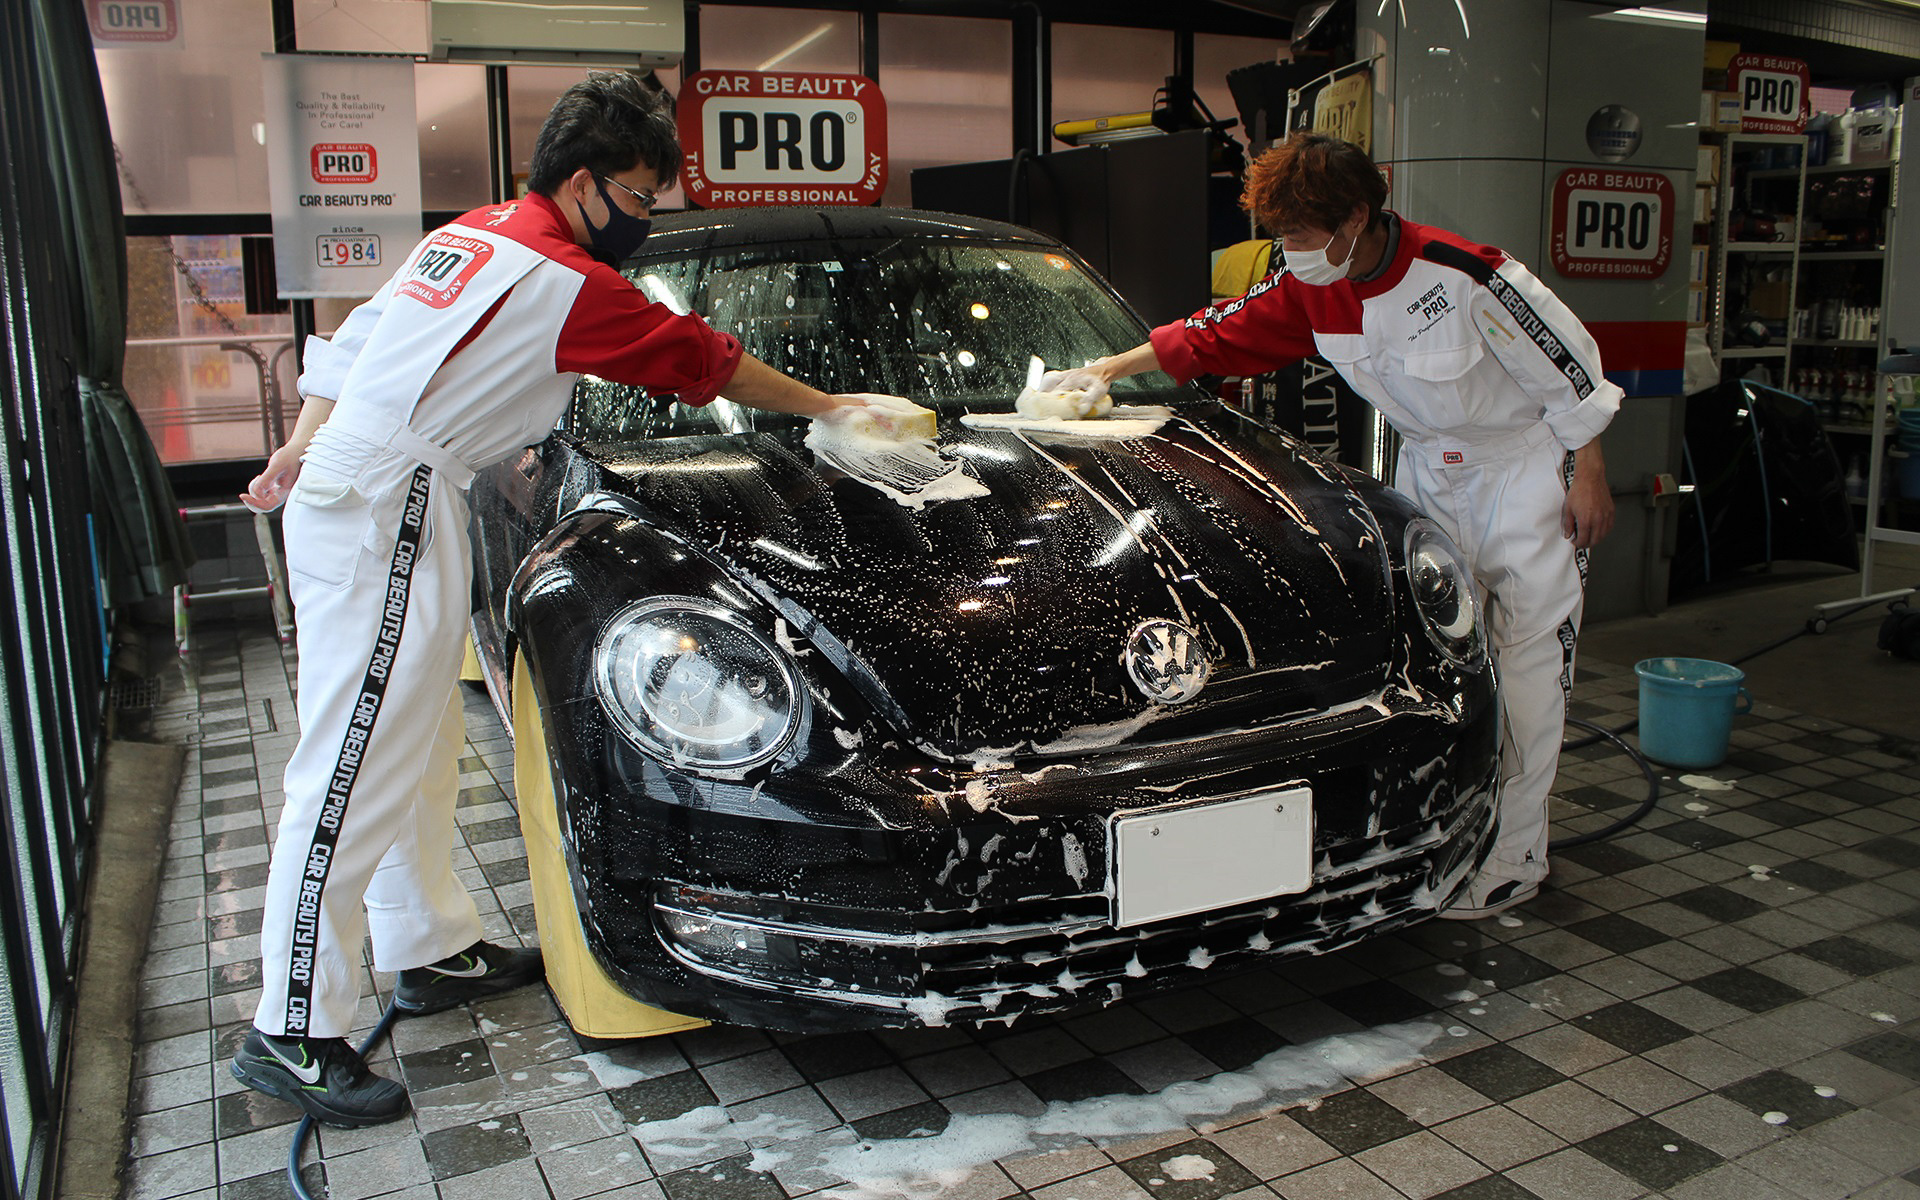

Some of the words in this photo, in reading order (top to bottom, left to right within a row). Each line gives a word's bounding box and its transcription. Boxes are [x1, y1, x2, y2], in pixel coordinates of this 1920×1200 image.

[1736, 56, 1759, 67] CAR
[1763, 58, 1803, 73] BEAUTY
[321, 92, 337, 100] The
[341, 92, 360, 100] Best
[696, 76, 749, 94] CAR
[763, 77, 866, 97] BEAUTY
[1744, 76, 1794, 115] PRO
[296, 102, 329, 111] Quality
[332, 102, 339, 110] &
[341, 102, 386, 111] Reliability
[308, 111, 317, 119] In
[320, 111, 375, 119] Professional
[320, 121, 336, 129] Car
[339, 121, 363, 129] Care!
[1743, 121, 1796, 133] ROFESSIONAL
[719, 110, 846, 172] PRO
[323, 154, 364, 173] PRO
[686, 151, 705, 192] THE
[863, 152, 881, 191] WAY
[711, 190, 858, 202] PROFESSIONAL
[1566, 173, 1598, 187] CAR
[1604, 174, 1664, 191] BEAUTY
[299, 194, 322, 207] CAR
[324, 194, 368, 207] BEAUTY
[1575, 200, 1650, 250] PRO
[321, 243, 376, 265] 1984
[451, 237, 490, 253] BEAUTY
[1556, 232, 1566, 264] THE
[1657, 236, 1669, 265] WAY
[1567, 263, 1653, 274] PROFESSIONAL
[440, 279, 463, 301] WAY
[1406, 301, 1422, 315] CAR
[1419, 281, 1444, 305] BEAUTY
[1422, 295, 1449, 320] PRO
[1488, 273, 1505, 296] AR
[1499, 287, 1543, 338] BEAUTY
[1564, 361, 1589, 390] CAR
[1302, 357, 1340, 461] ATIN
[393, 540, 416, 576] CAR
[381, 576, 408, 643] BEAUTY
[352, 691, 380, 727] CAR
[331, 726, 368, 793] BEAUTY
[305, 843, 331, 878] CAR
[295, 879, 322, 945] BEAUTY
[286, 996, 307, 1030] CAR
